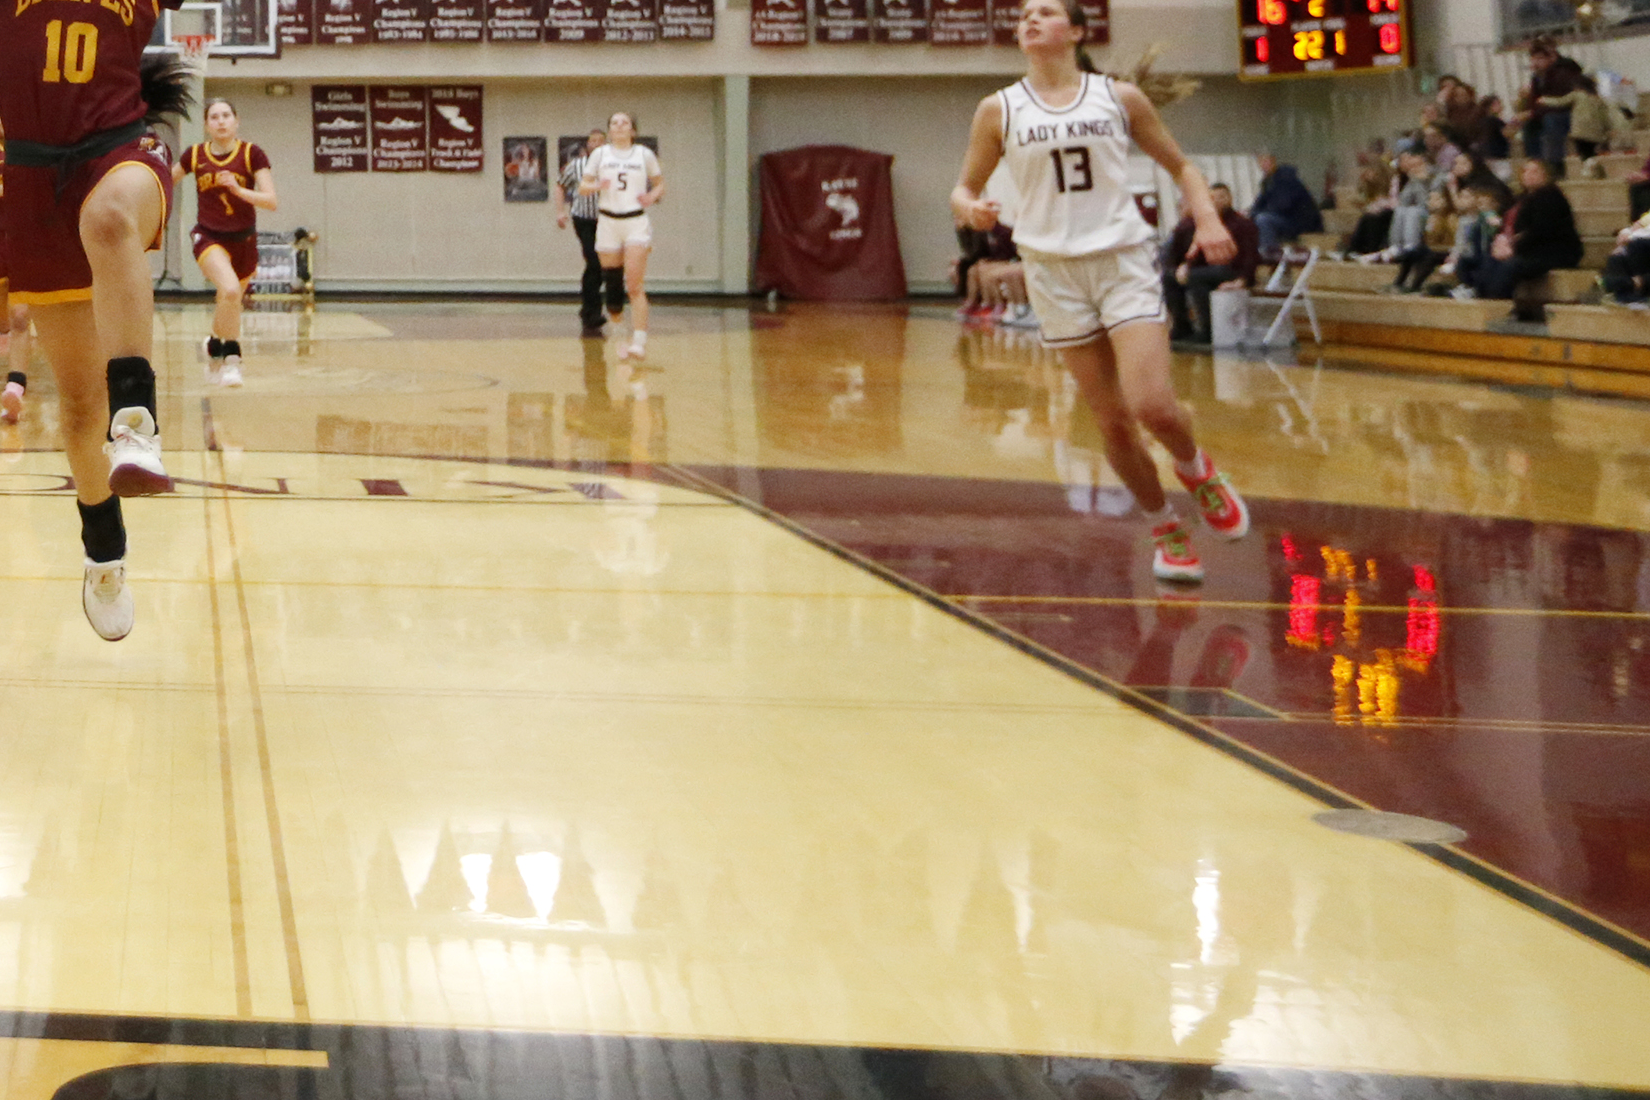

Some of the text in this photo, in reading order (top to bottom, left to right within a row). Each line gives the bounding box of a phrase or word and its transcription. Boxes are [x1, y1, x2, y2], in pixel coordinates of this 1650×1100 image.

[373, 19, 426, 29] Champions
[430, 19, 482, 29] Champions
[1256, 36, 1269, 62] 1
[1379, 23, 1401, 53] 0
[43, 19, 99, 83] 10
[315, 102, 366, 113] Swimming
[375, 99, 423, 111] Swimming
[1016, 119, 1115, 147] LADY KINGS
[320, 136, 352, 147] Region
[380, 138, 411, 150] Region
[438, 138, 466, 148] Region
[316, 146, 368, 156] Champions
[374, 149, 425, 159] Champions
[433, 159, 479, 170] Champions
[1050, 146, 1094, 193] 13
[617, 173, 627, 191] 5
